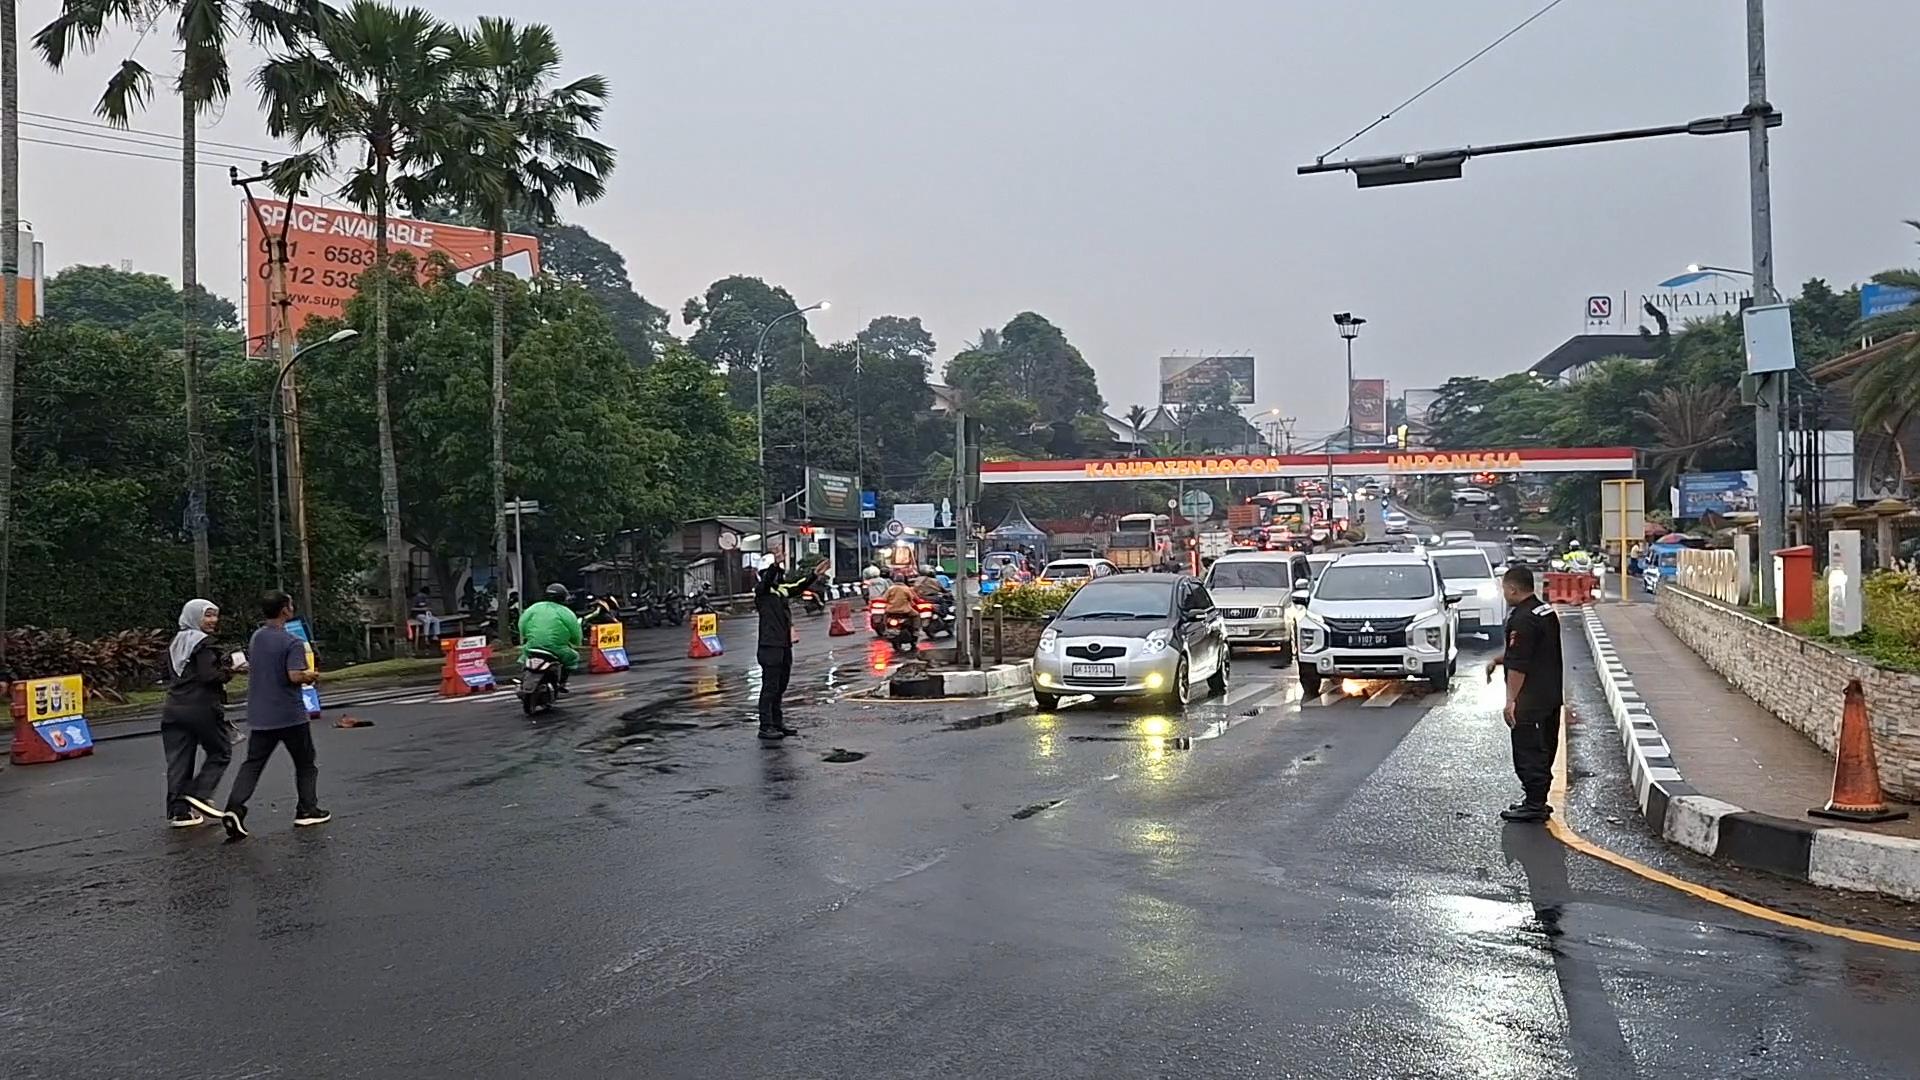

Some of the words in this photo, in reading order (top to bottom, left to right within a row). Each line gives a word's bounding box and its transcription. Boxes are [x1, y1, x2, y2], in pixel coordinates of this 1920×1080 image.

[259, 204, 328, 233] SPACE
[259, 237, 298, 257] 01
[258, 262, 314, 284] 012
[1085, 460, 1202, 478] KABUPATEN
[1206, 458, 1280, 475] BOGOR
[1387, 452, 1521, 469] INDONESIA
